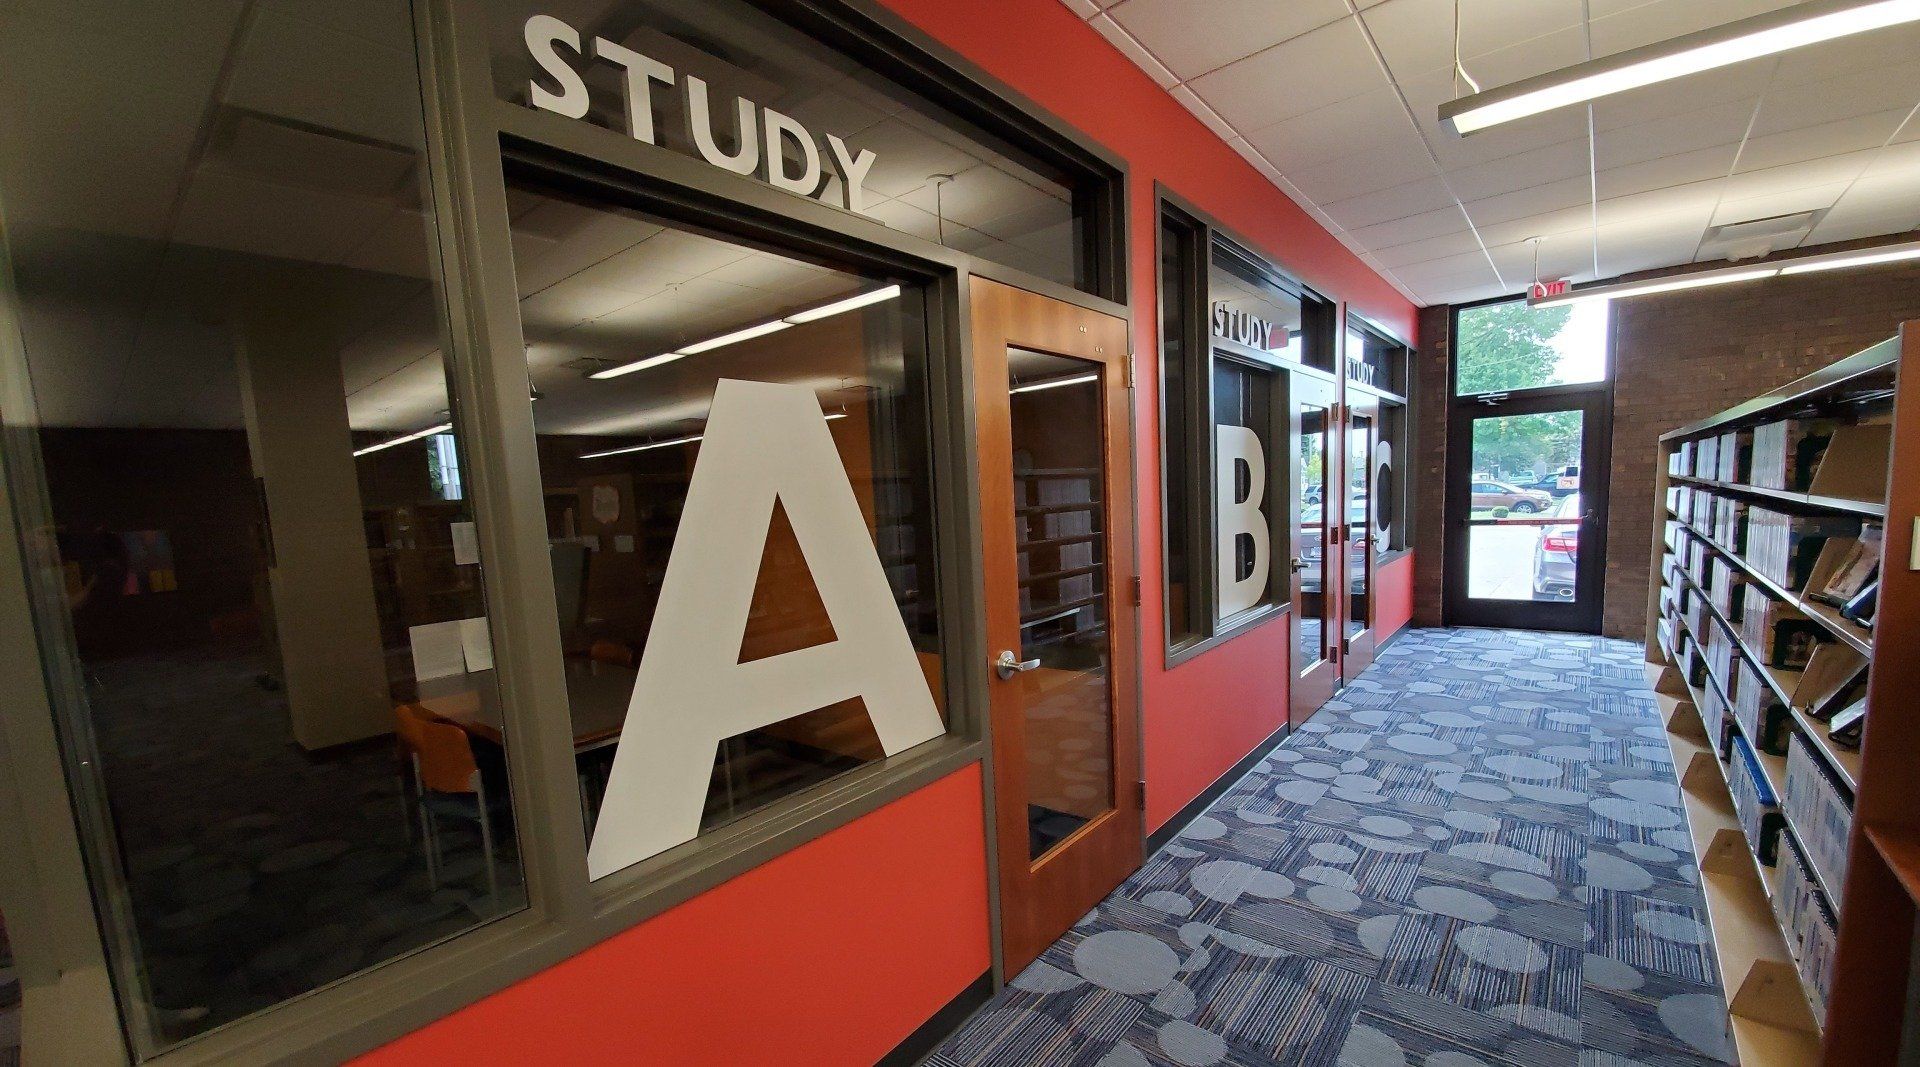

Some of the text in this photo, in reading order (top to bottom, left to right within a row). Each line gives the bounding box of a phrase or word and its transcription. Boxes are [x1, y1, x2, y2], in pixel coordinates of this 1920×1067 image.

[524, 14, 877, 213] STUDY
[1214, 301, 1272, 350] STUDY
[1346, 357, 1375, 386] STUDY
[1217, 424, 1270, 619] B
[587, 378, 946, 882] A
